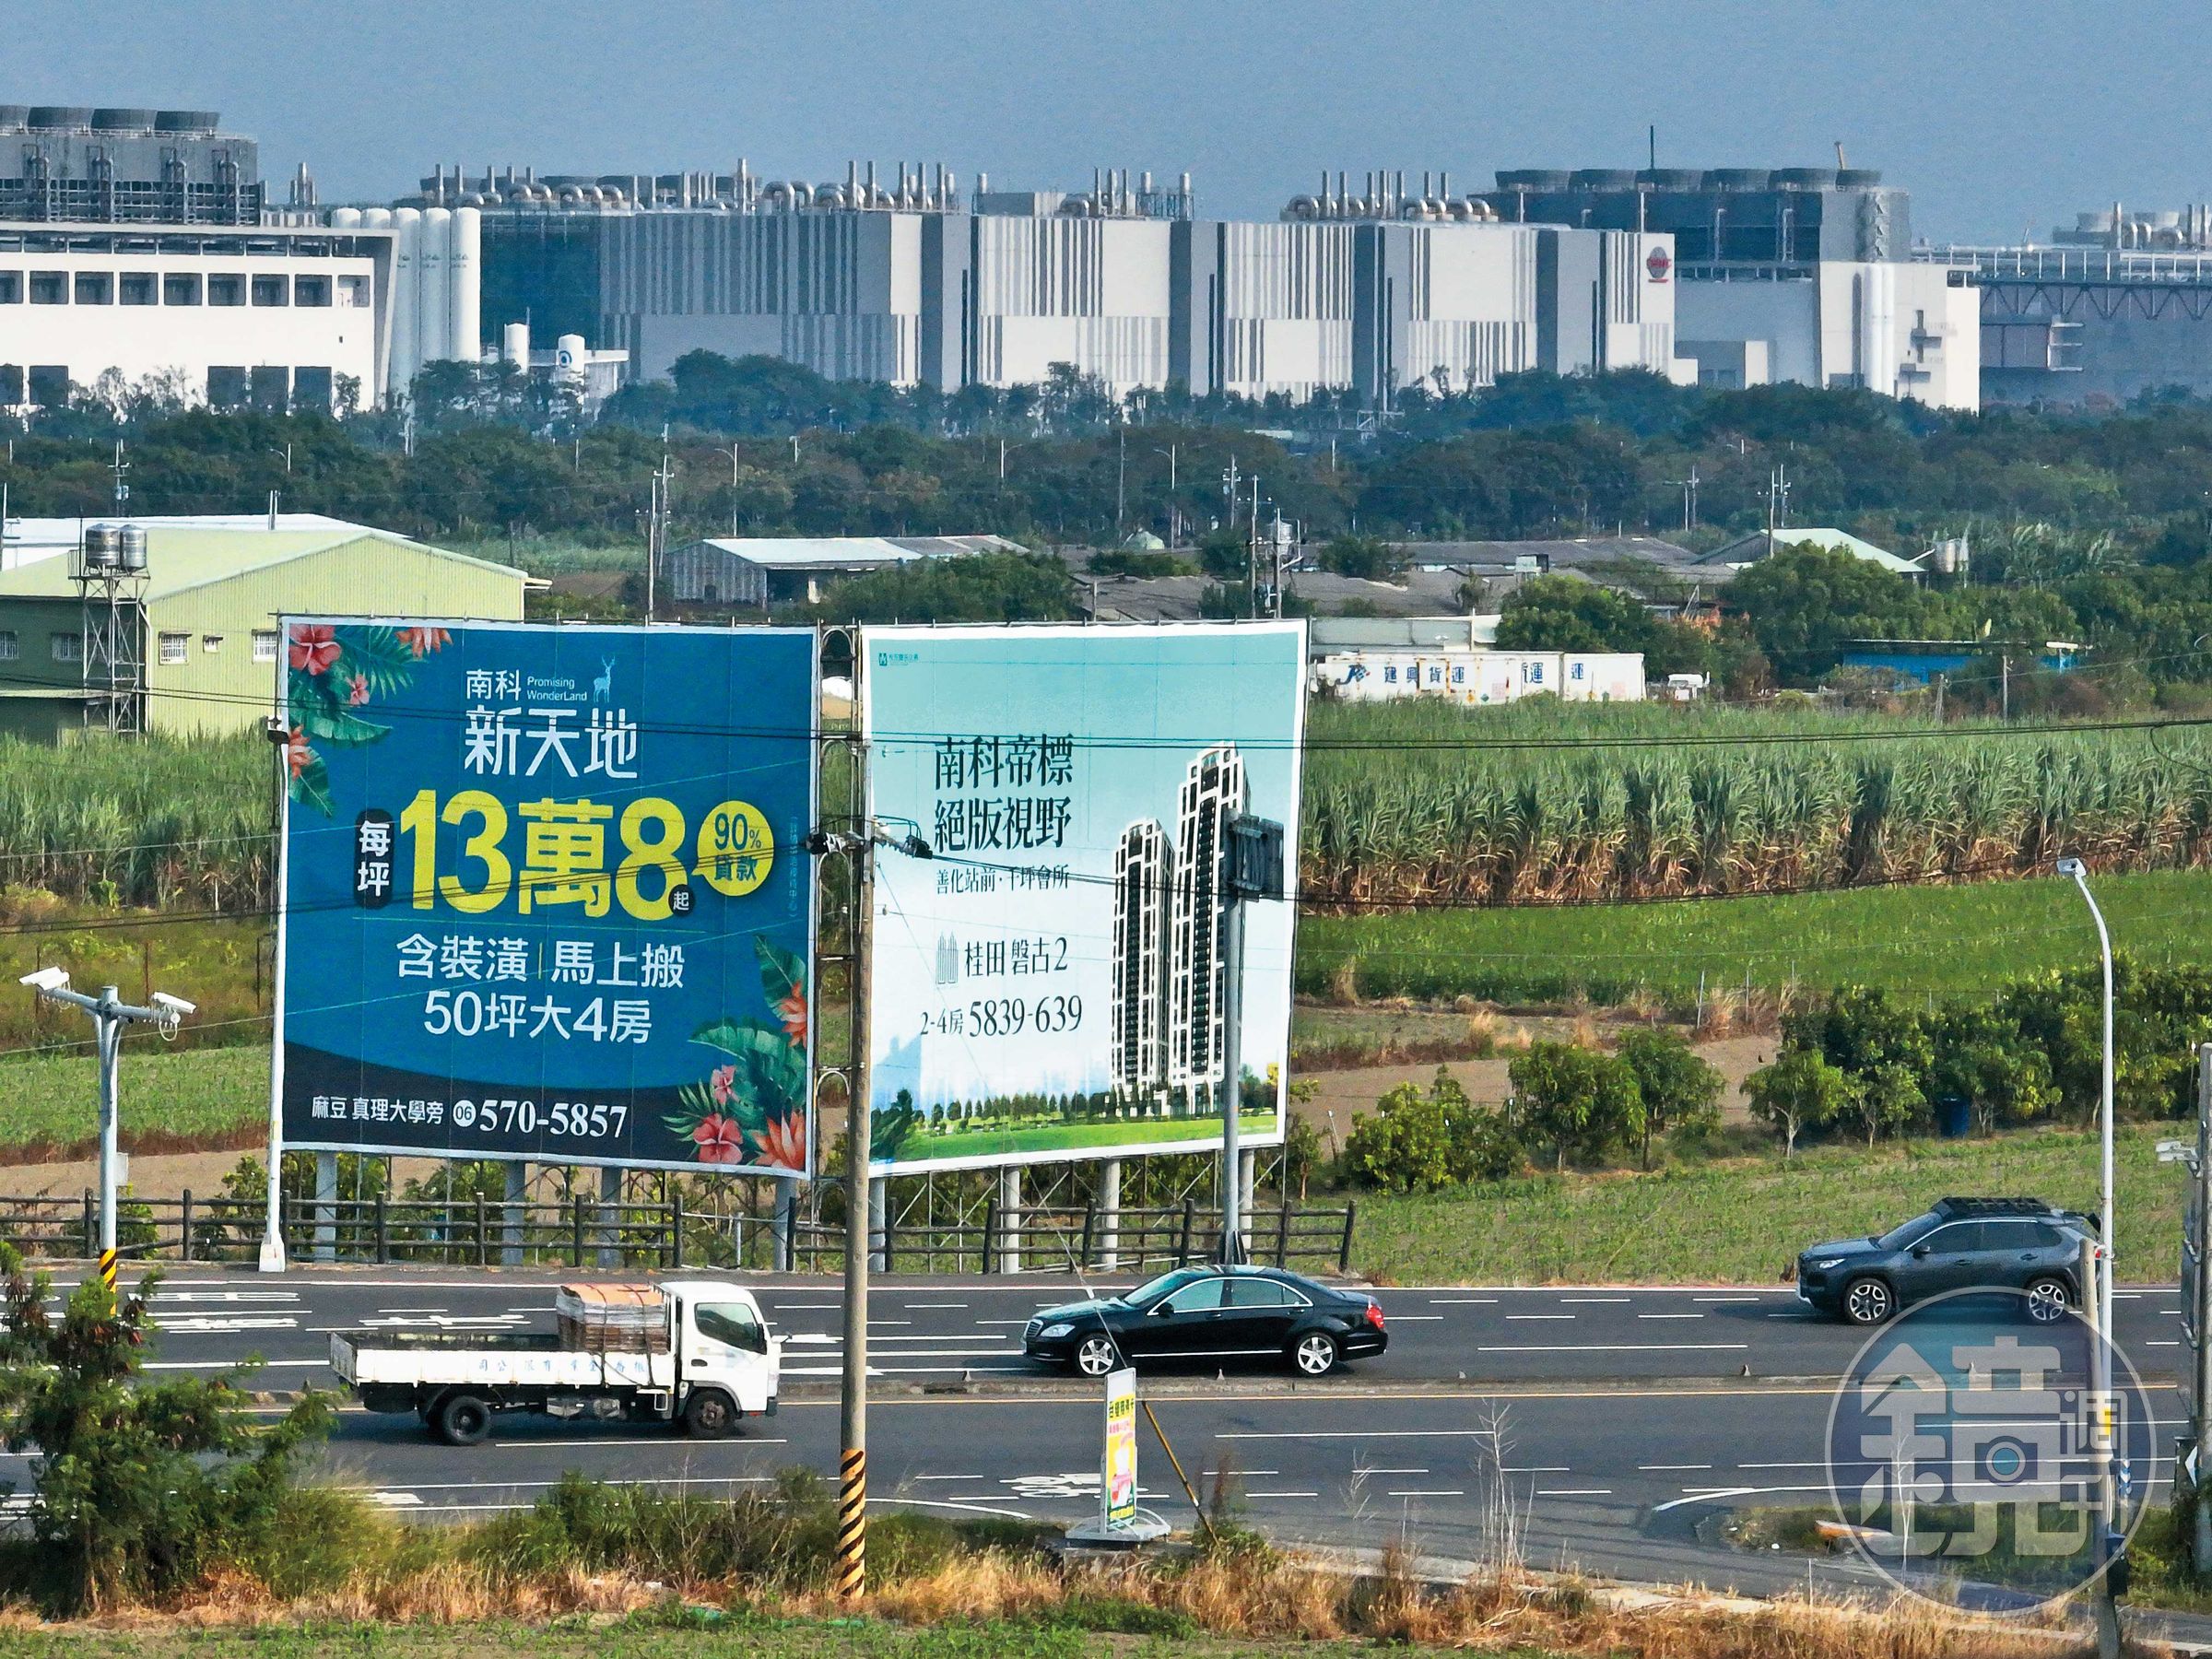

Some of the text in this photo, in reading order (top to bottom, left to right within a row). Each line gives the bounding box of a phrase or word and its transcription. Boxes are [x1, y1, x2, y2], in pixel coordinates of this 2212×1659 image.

[465, 668, 523, 701] 南科
[526, 689, 587, 701] WonderLand
[527, 676, 575, 689] Promising
[464, 704, 639, 779] 新天地
[935, 732, 1074, 790] 南科帝標
[713, 812, 763, 852] 90%
[934, 796, 1072, 853] 絕版視野
[357, 820, 392, 898] 每坪
[400, 788, 691, 921] 13萬8 起
[712, 854, 759, 884] 貸款
[395, 933, 686, 989] 含裝潢 馬上搬
[423, 990, 653, 1044] 50坪大4房
[920, 994, 1083, 1037] 2-4房 5839-639
[479, 1100, 629, 1139] 570-5857
